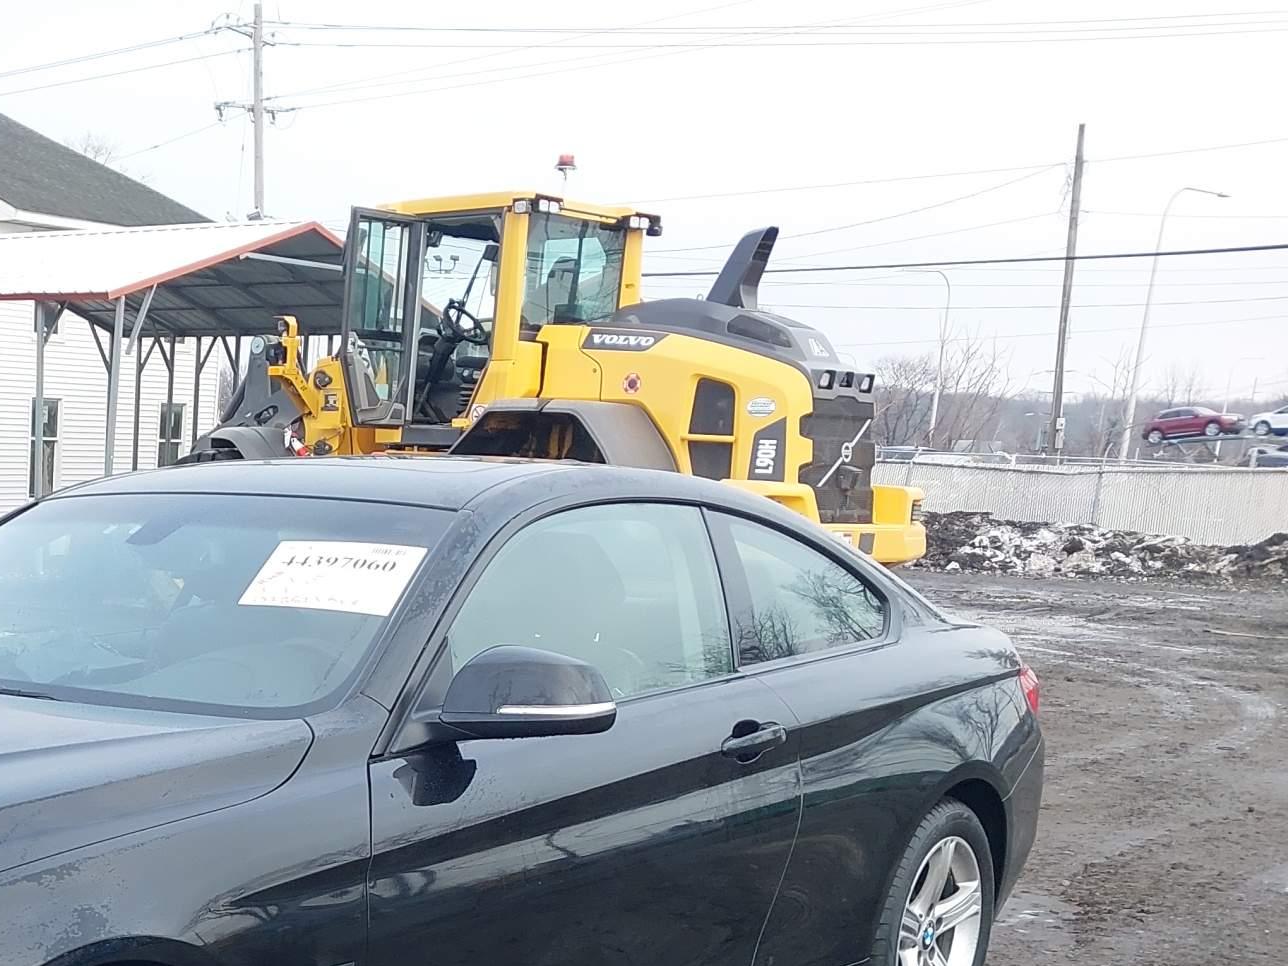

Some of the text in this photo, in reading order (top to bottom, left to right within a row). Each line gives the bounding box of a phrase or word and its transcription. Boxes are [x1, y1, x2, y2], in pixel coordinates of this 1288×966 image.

[592, 333, 655, 346] VOLVO
[754, 439, 778, 475] L90H
[281, 554, 397, 573] 44397060
